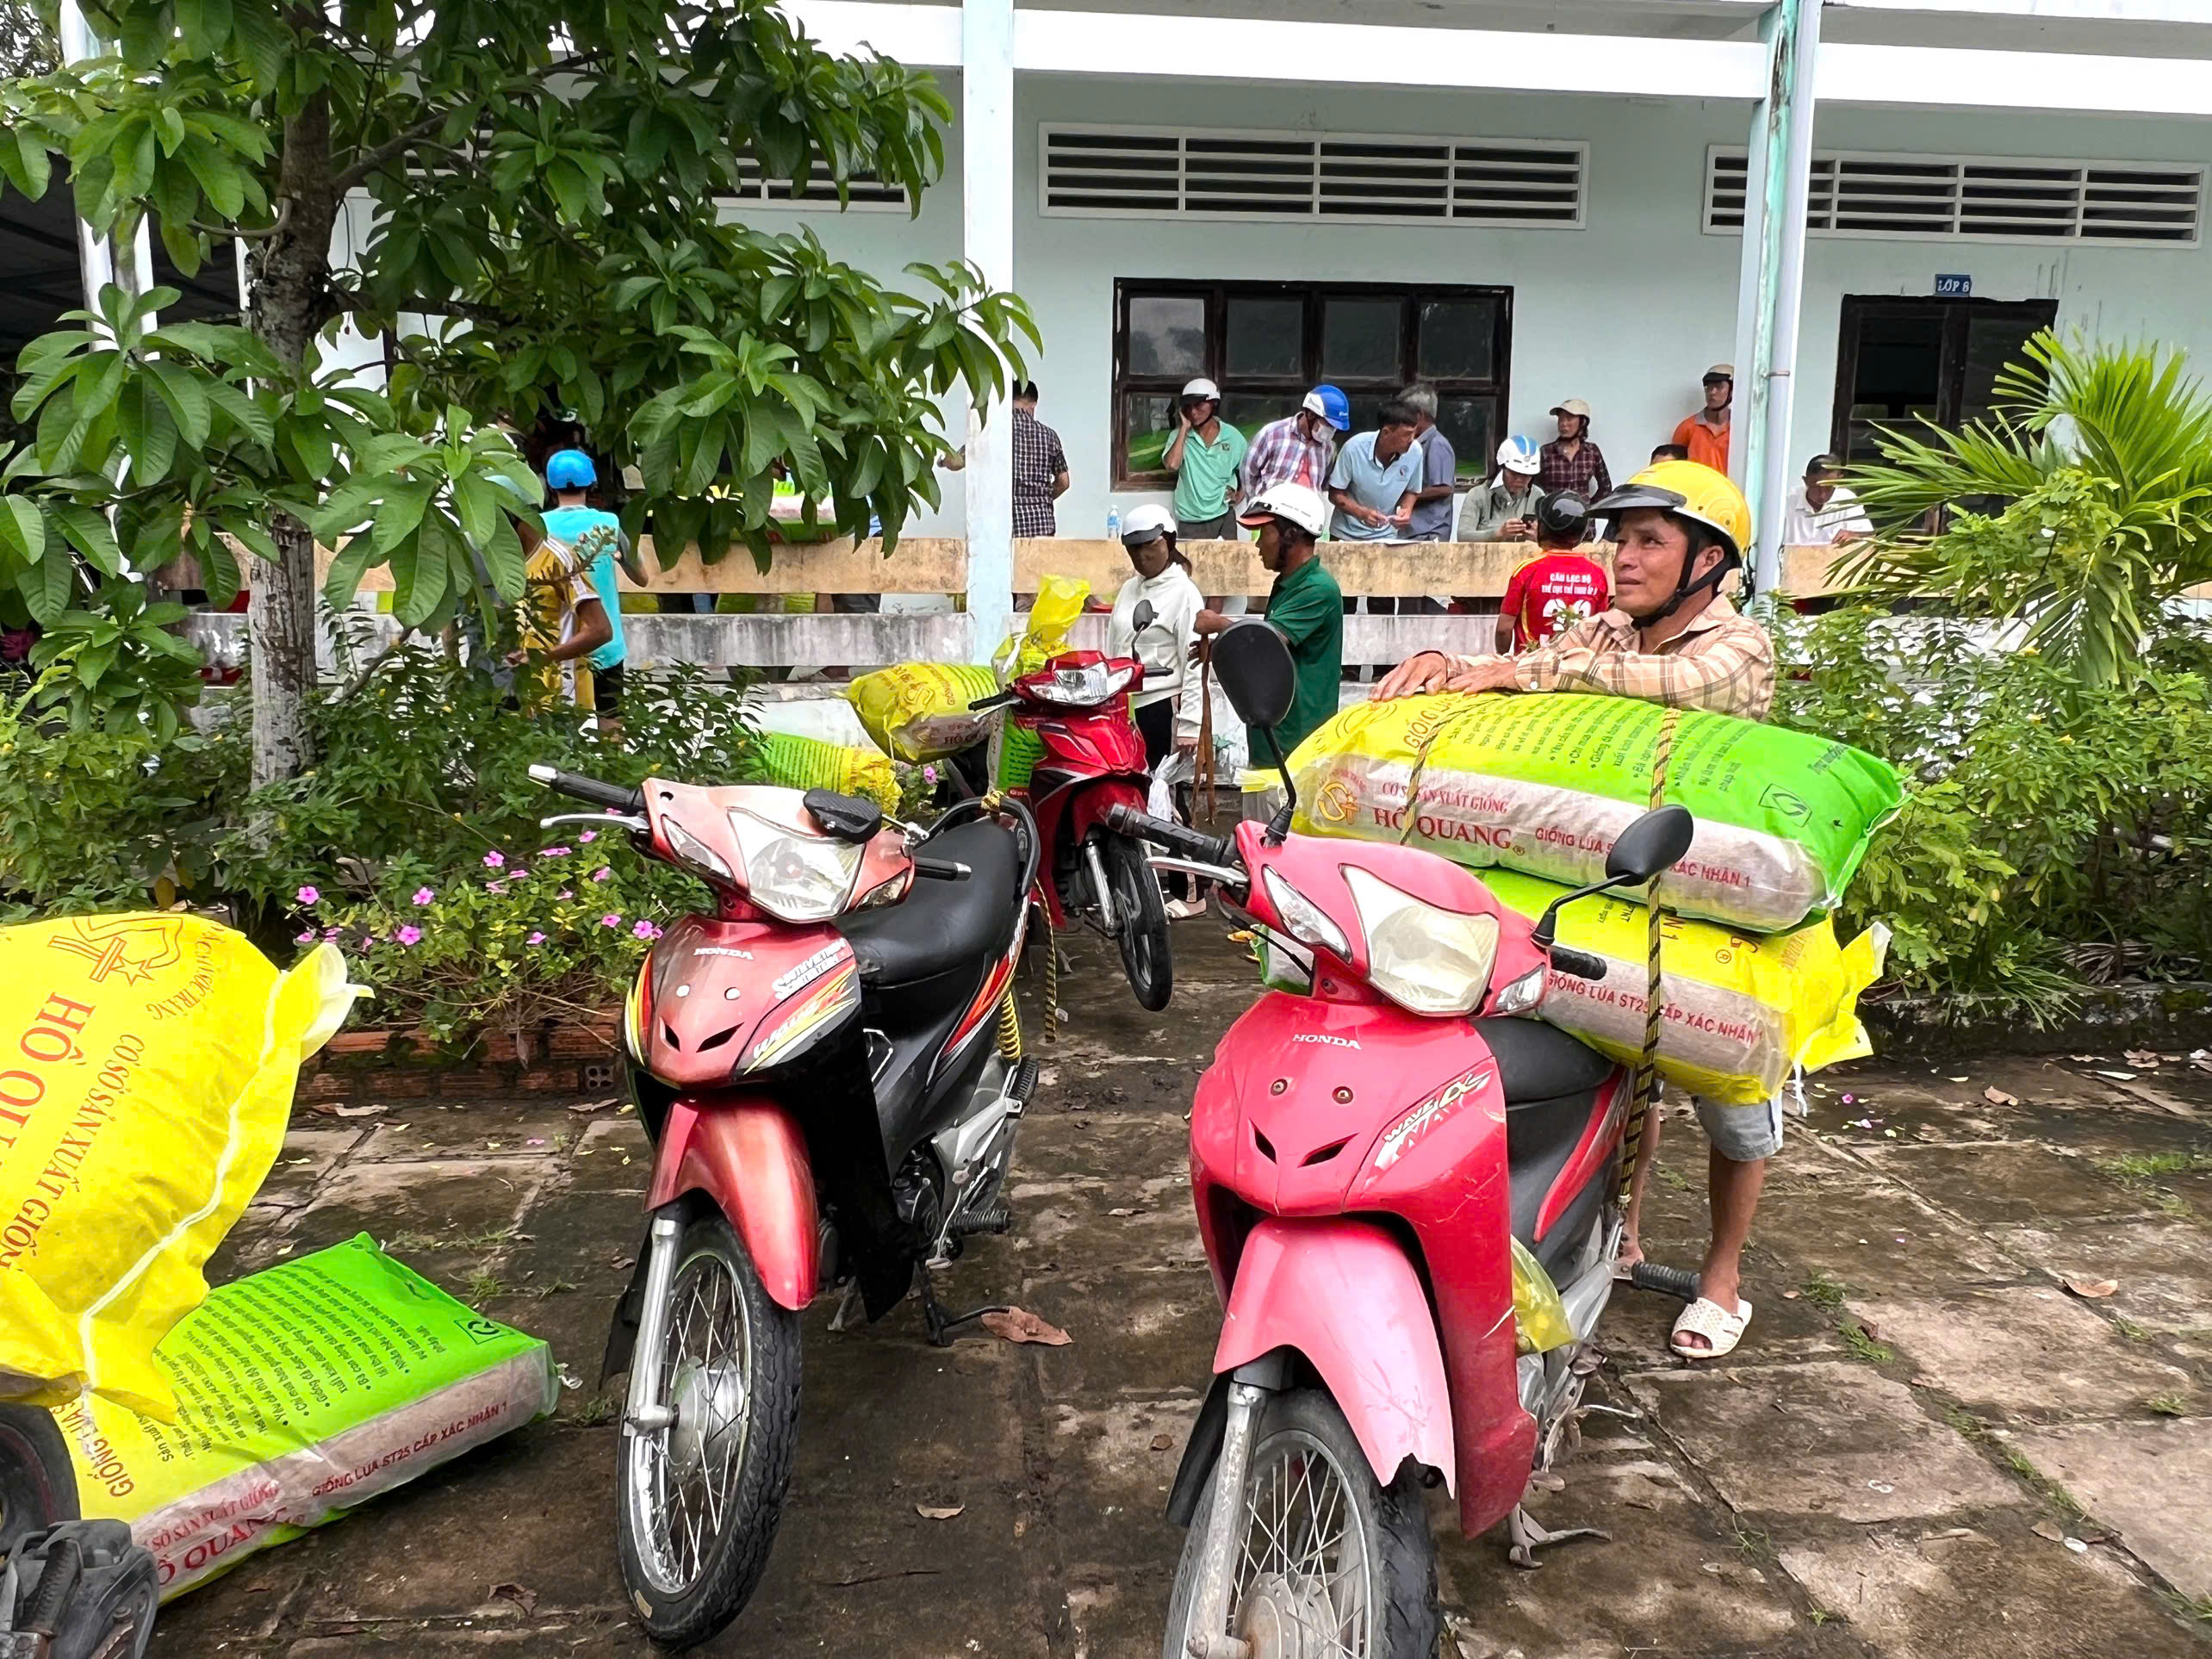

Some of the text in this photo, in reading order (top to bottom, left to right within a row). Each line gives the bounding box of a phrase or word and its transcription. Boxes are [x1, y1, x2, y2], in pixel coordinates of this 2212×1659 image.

[1417, 814, 1513, 852] QUANG
[1534, 823, 1576, 847] GIỐNG
[693, 947, 754, 960] HONDA
[21, 992, 96, 1066] HỒ
[109, 1031, 147, 1066] CƠ
[1292, 1034, 1362, 1050] HONDA
[70, 1087, 118, 1139] SẢN
[1383, 1097, 1437, 1143] WAVE
[34, 1130, 93, 1204] XUẤT
[0, 1195, 53, 1276] GIỐN
